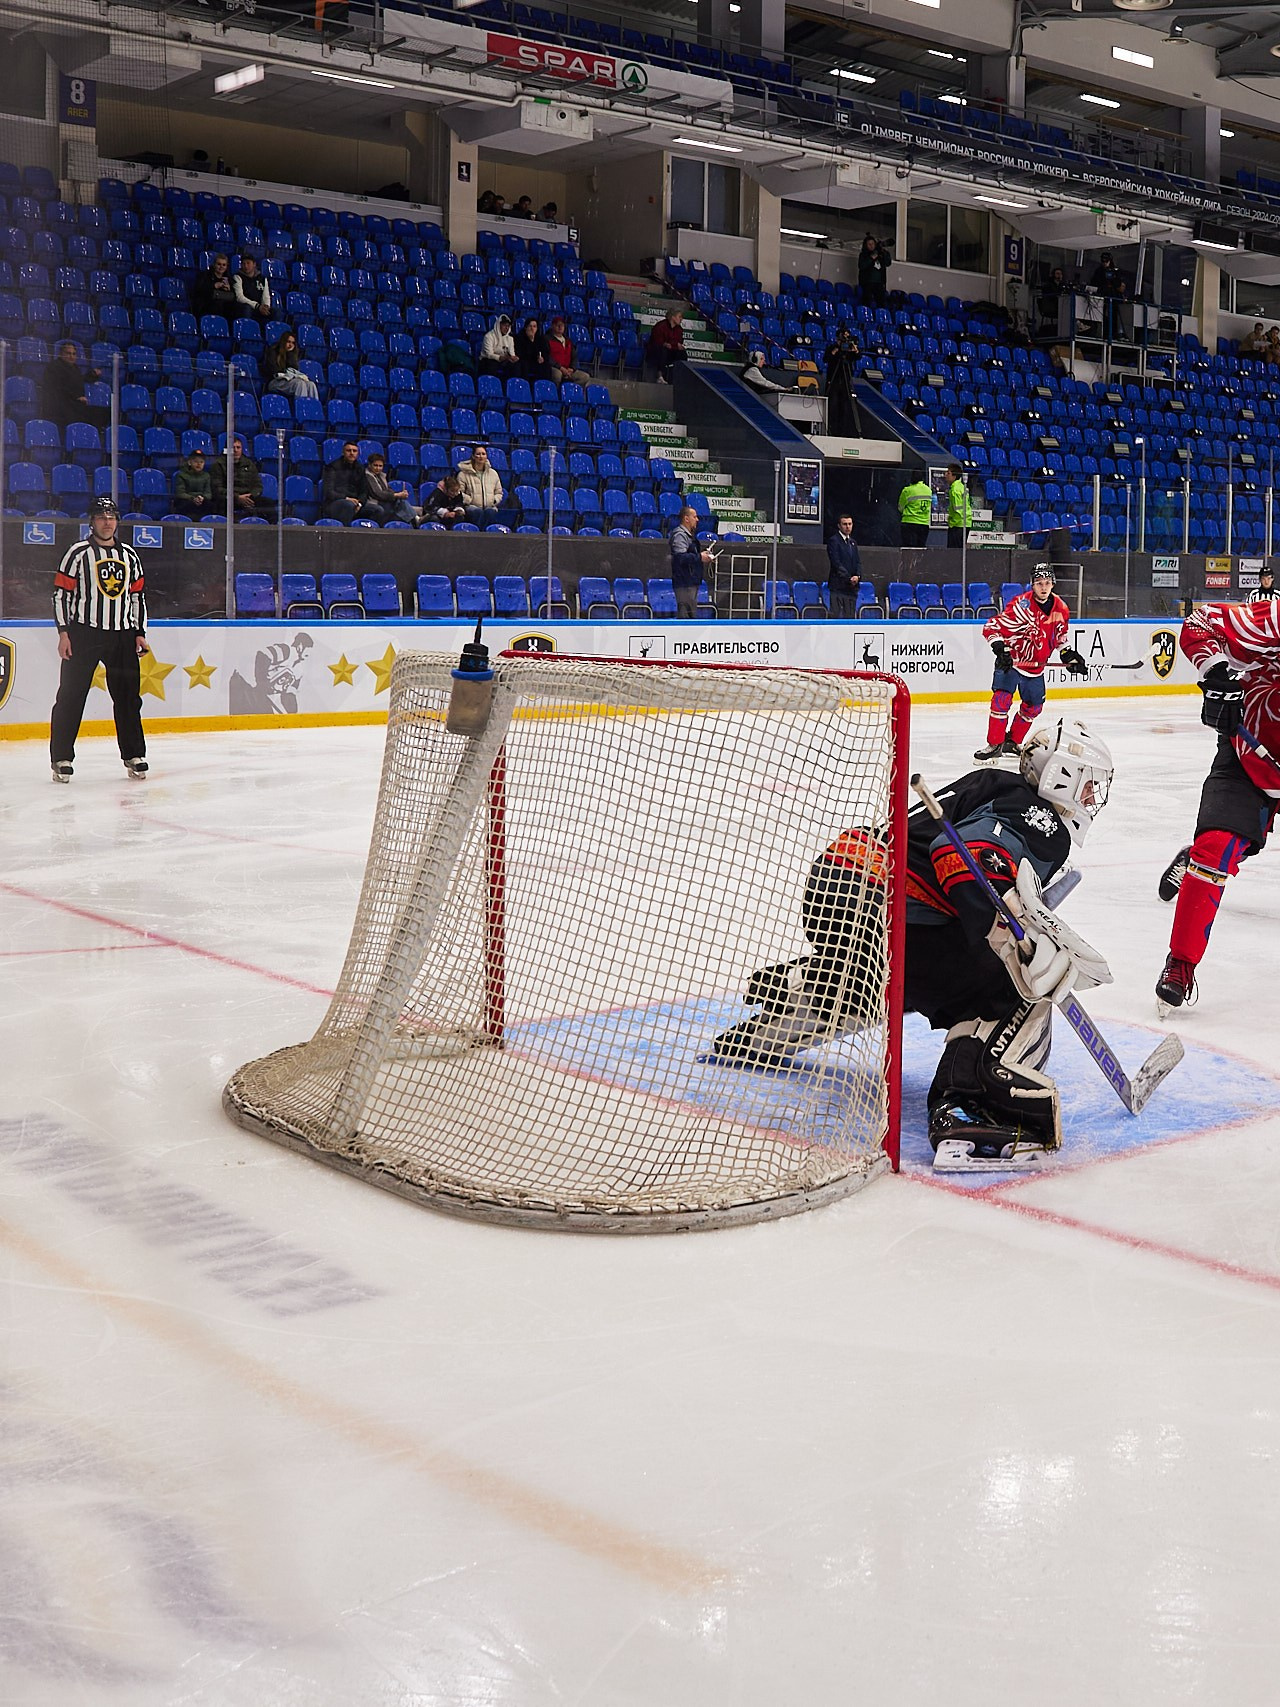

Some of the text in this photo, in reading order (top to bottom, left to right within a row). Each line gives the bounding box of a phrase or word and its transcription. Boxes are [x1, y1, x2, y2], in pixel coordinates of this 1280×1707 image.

[518, 45, 614, 83] SPAR
[70, 79, 86, 105] 8
[915, 134, 975, 158] ЧЕМПИОНАТ
[1017, 159, 1031, 170] ПО
[1032, 162, 1069, 178] ХОККЕЮ
[460, 164, 469, 177] 1
[569, 228, 578, 241] 5
[1010, 243, 1018, 261] 9
[643, 424, 673, 434] SYNERGETIC
[664, 449, 694, 459] SYNERGETIC
[687, 473, 717, 483] SYNERGETIC
[704, 486, 729, 494] ЧИСТОТЫ
[711, 498, 742, 508] SYNERGETIC
[728, 511, 752, 519] КРАСОТЫ
[735, 524, 765, 533] SYNERGETIC
[1154, 559, 1178, 568] PARI
[1205, 577, 1230, 586] FONBET
[673, 641, 780, 655] ПРАВИТЕЛЬСТВО
[891, 641, 944, 656] НИЖНИЙ
[1074, 630, 1106, 658] ГА
[891, 660, 955, 675] НОВГОРОД
[1047, 669, 1104, 683] ЛЬНЫХ
[1205, 690, 1244, 700] CC
[1067, 1002, 1127, 1093] BAUER
